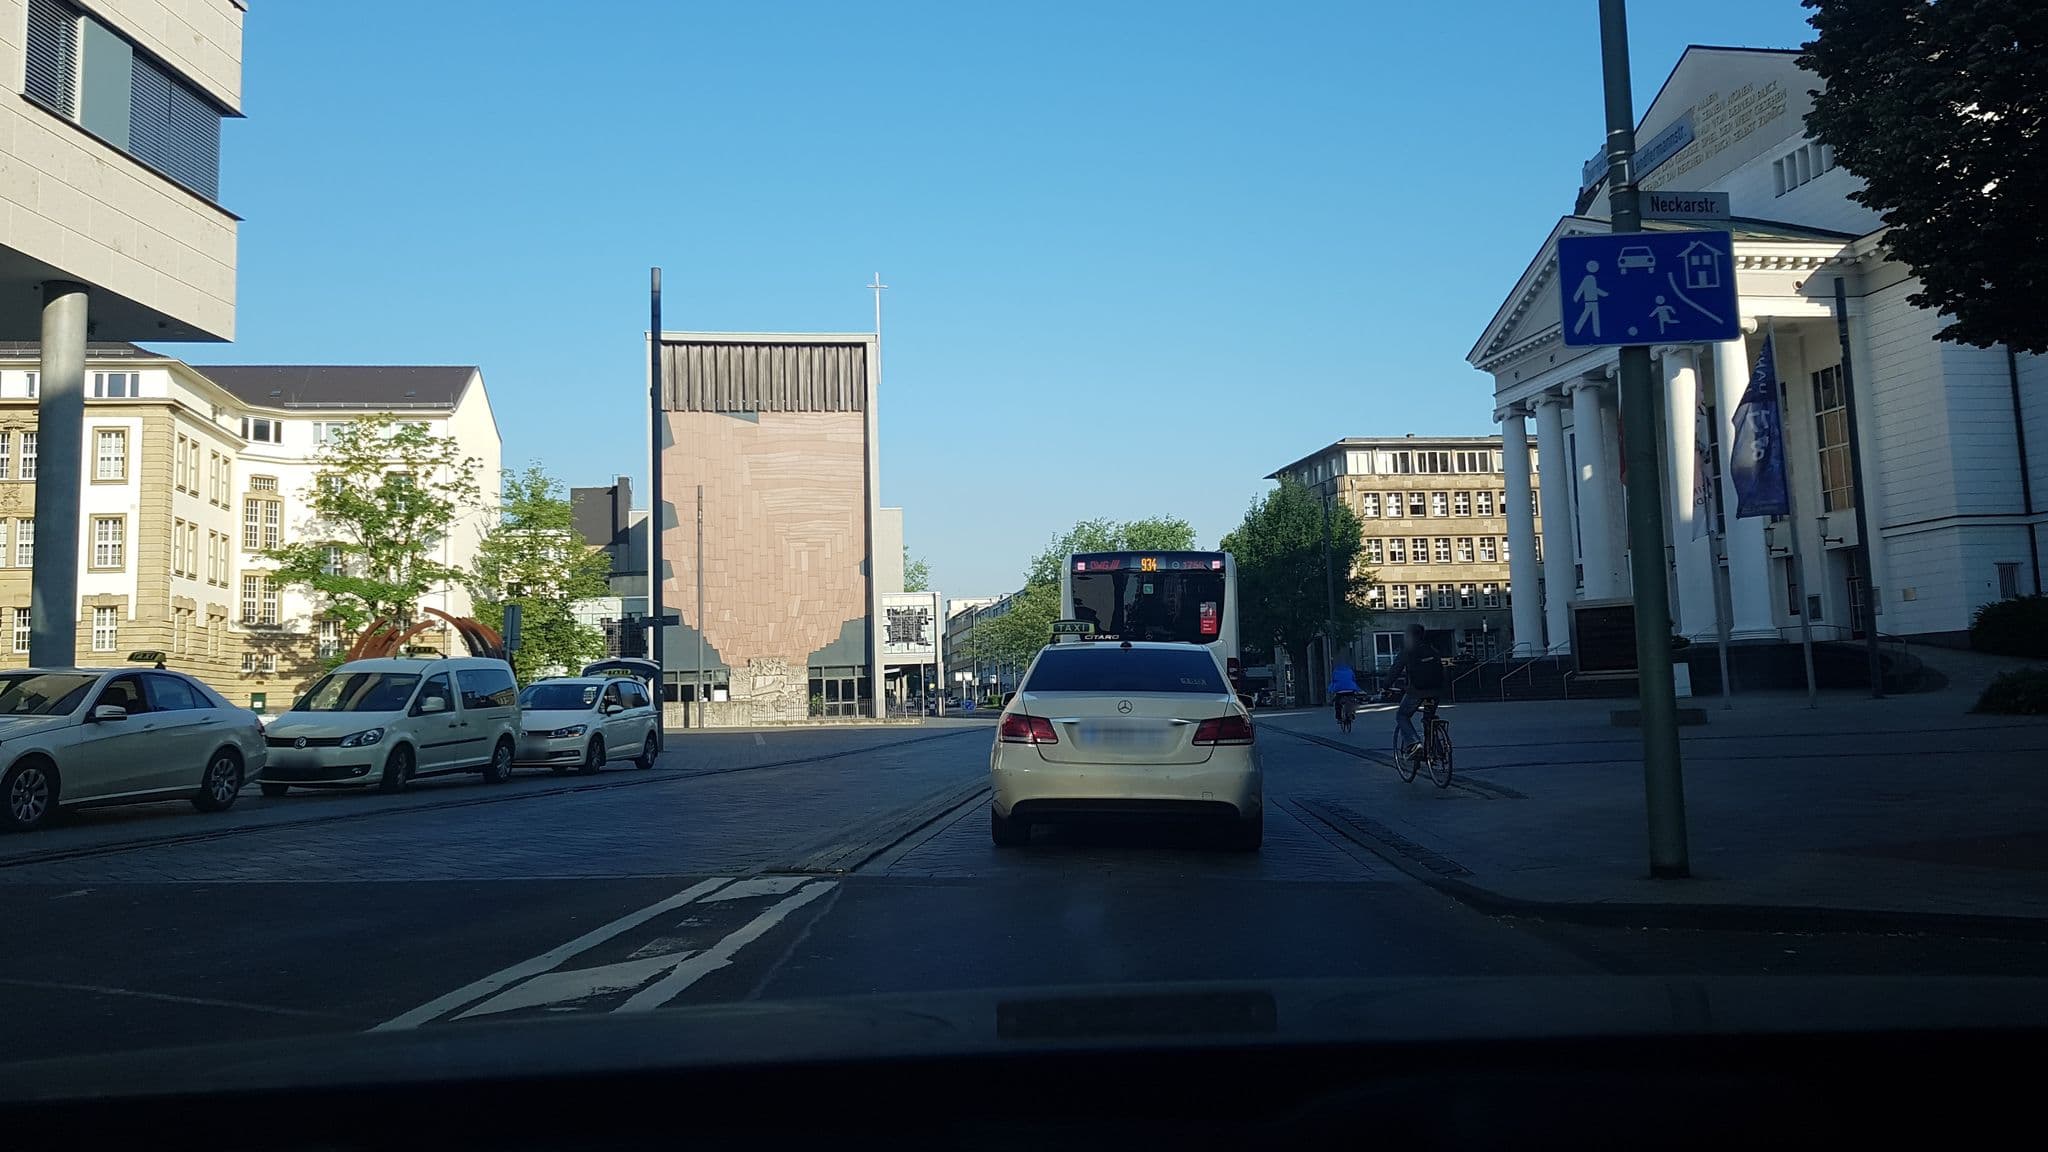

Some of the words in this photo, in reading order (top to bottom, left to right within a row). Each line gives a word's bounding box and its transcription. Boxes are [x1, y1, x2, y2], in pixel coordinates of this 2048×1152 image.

[1650, 195, 1720, 213] Neckarstr.
[1141, 558, 1157, 571] 934
[1058, 624, 1085, 632] TAXI
